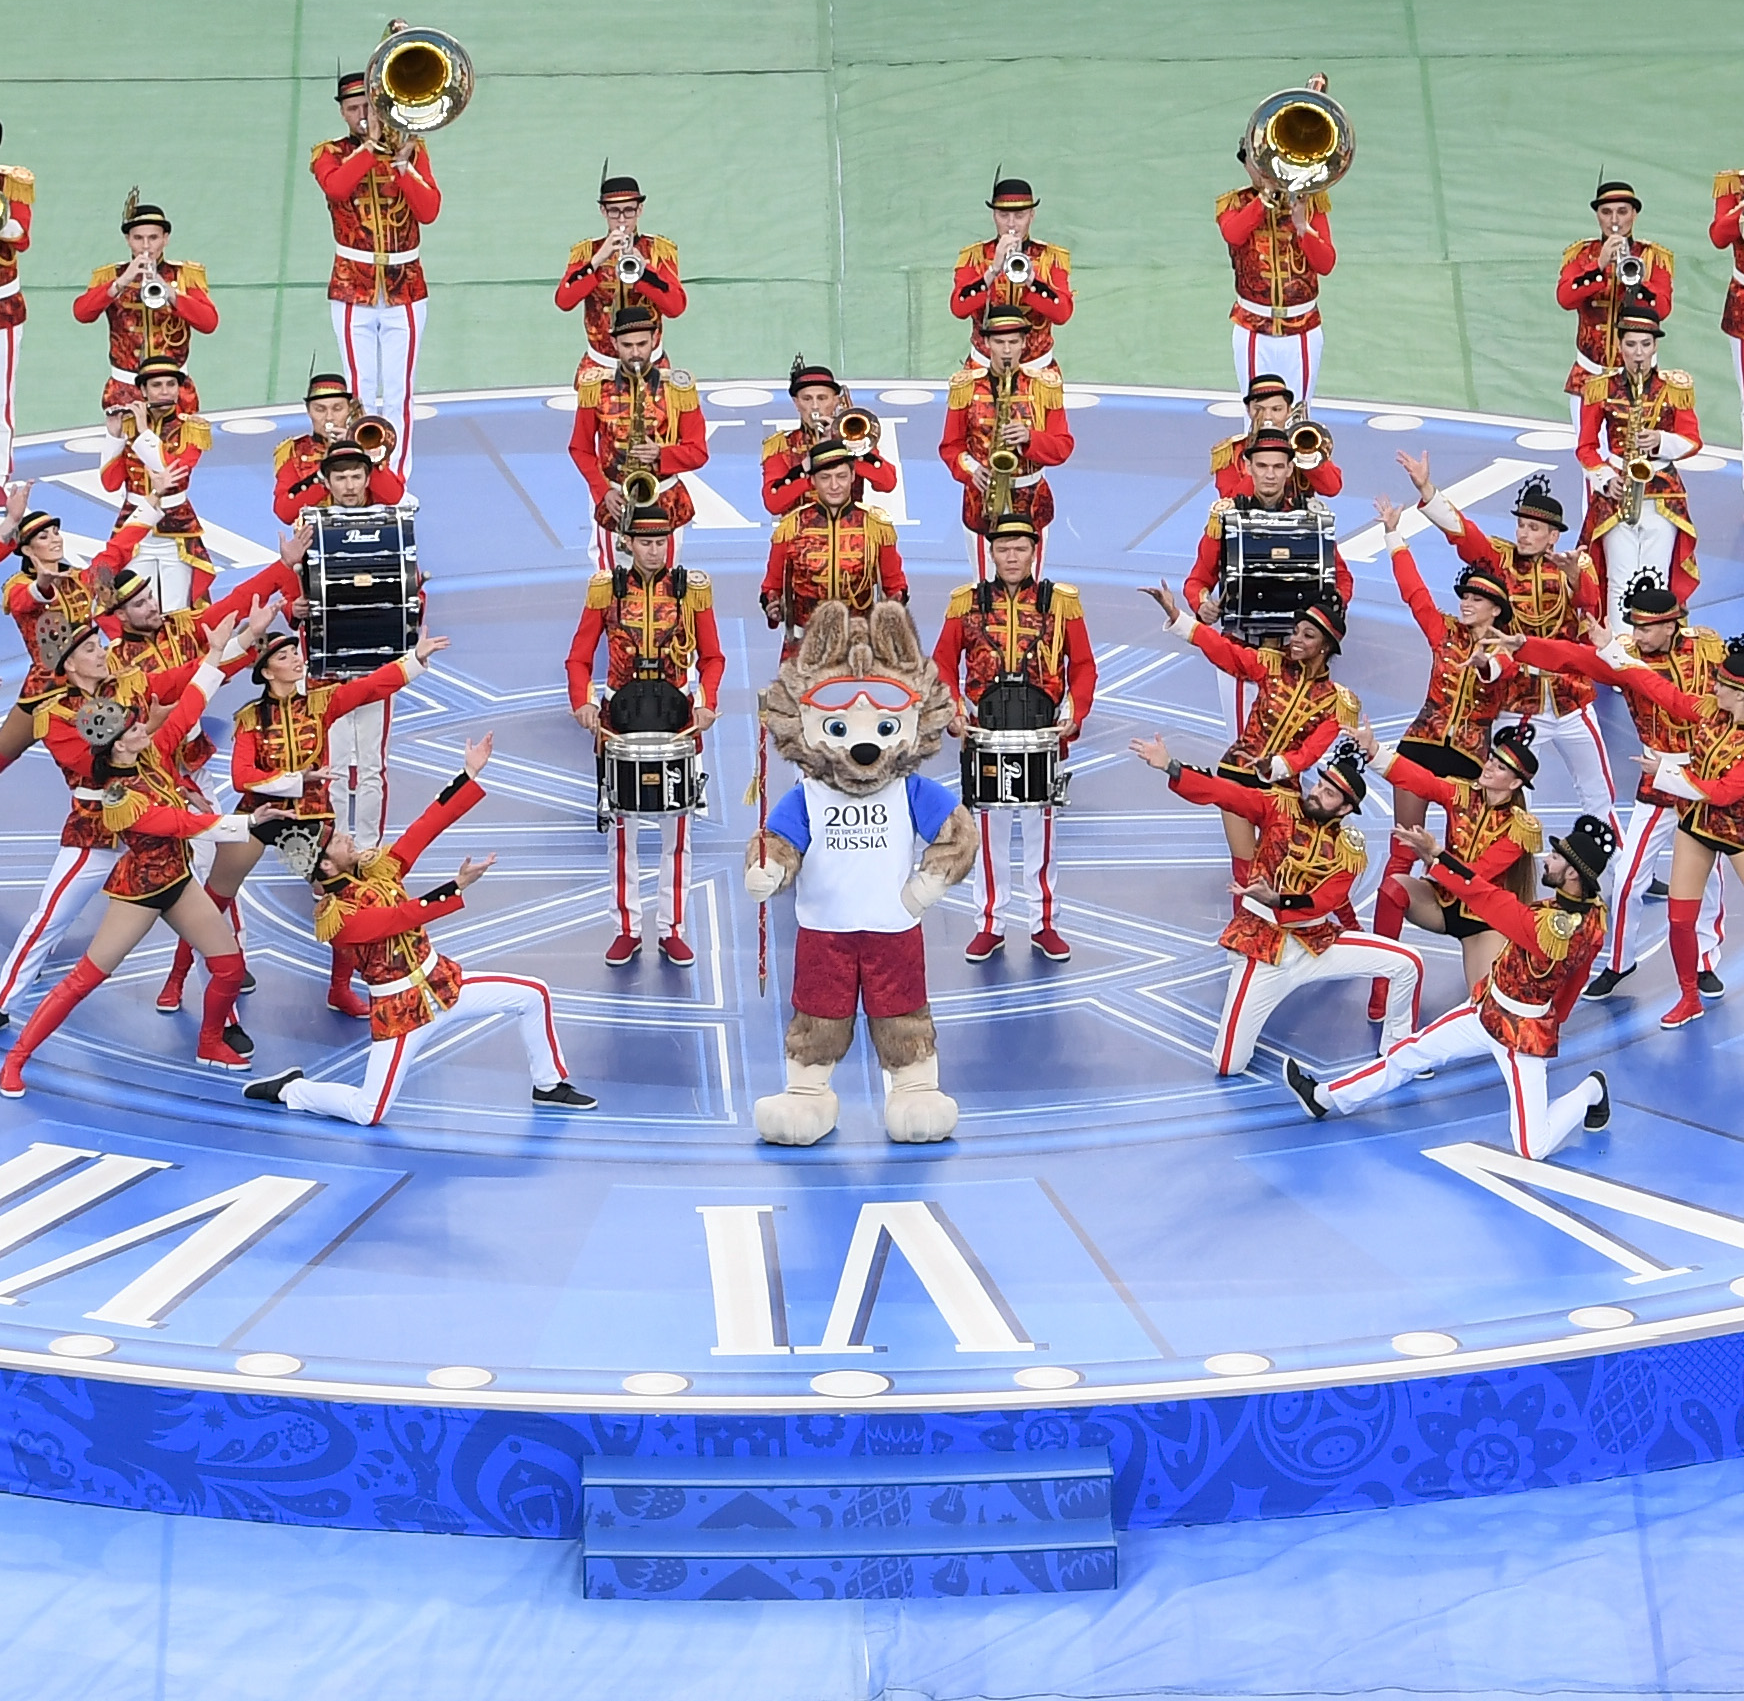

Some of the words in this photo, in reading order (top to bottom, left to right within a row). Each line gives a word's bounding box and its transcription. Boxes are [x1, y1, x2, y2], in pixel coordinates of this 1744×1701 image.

[342, 529, 381, 543] Pearl
[824, 804, 888, 827] 2018
[825, 828, 841, 836] FIFA
[841, 827, 871, 835] WORLD
[871, 826, 889, 834] CUP
[826, 835, 888, 850] RUSSIA
